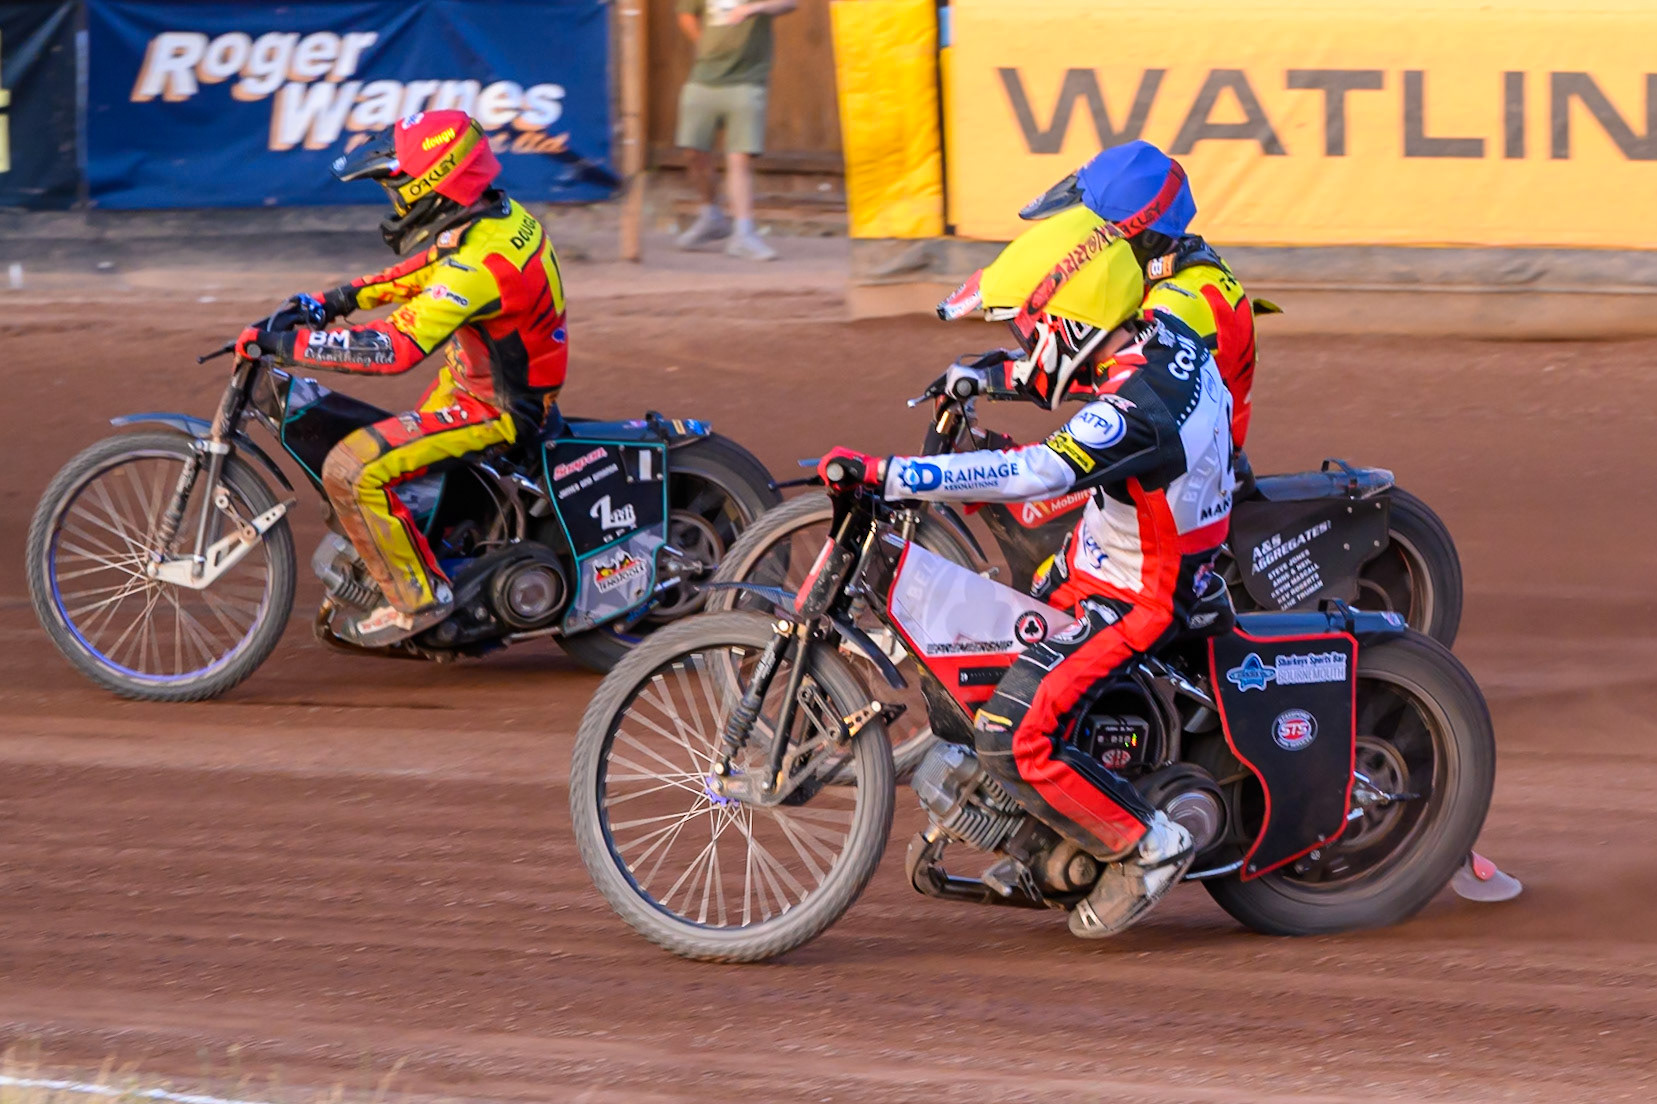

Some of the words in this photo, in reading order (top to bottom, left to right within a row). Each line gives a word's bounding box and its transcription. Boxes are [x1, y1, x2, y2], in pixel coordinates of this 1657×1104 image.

[131, 31, 379, 102] Roger
[269, 80, 567, 151] Warnes
[998, 67, 1657, 160] WATLIN
[410, 153, 457, 196] OAKLEY
[1119, 201, 1162, 236] AKLEY
[308, 329, 350, 349] BM
[1079, 411, 1114, 435] ATPI
[1267, 562, 1288, 580] STEVE
[1280, 722, 1309, 737] STS
